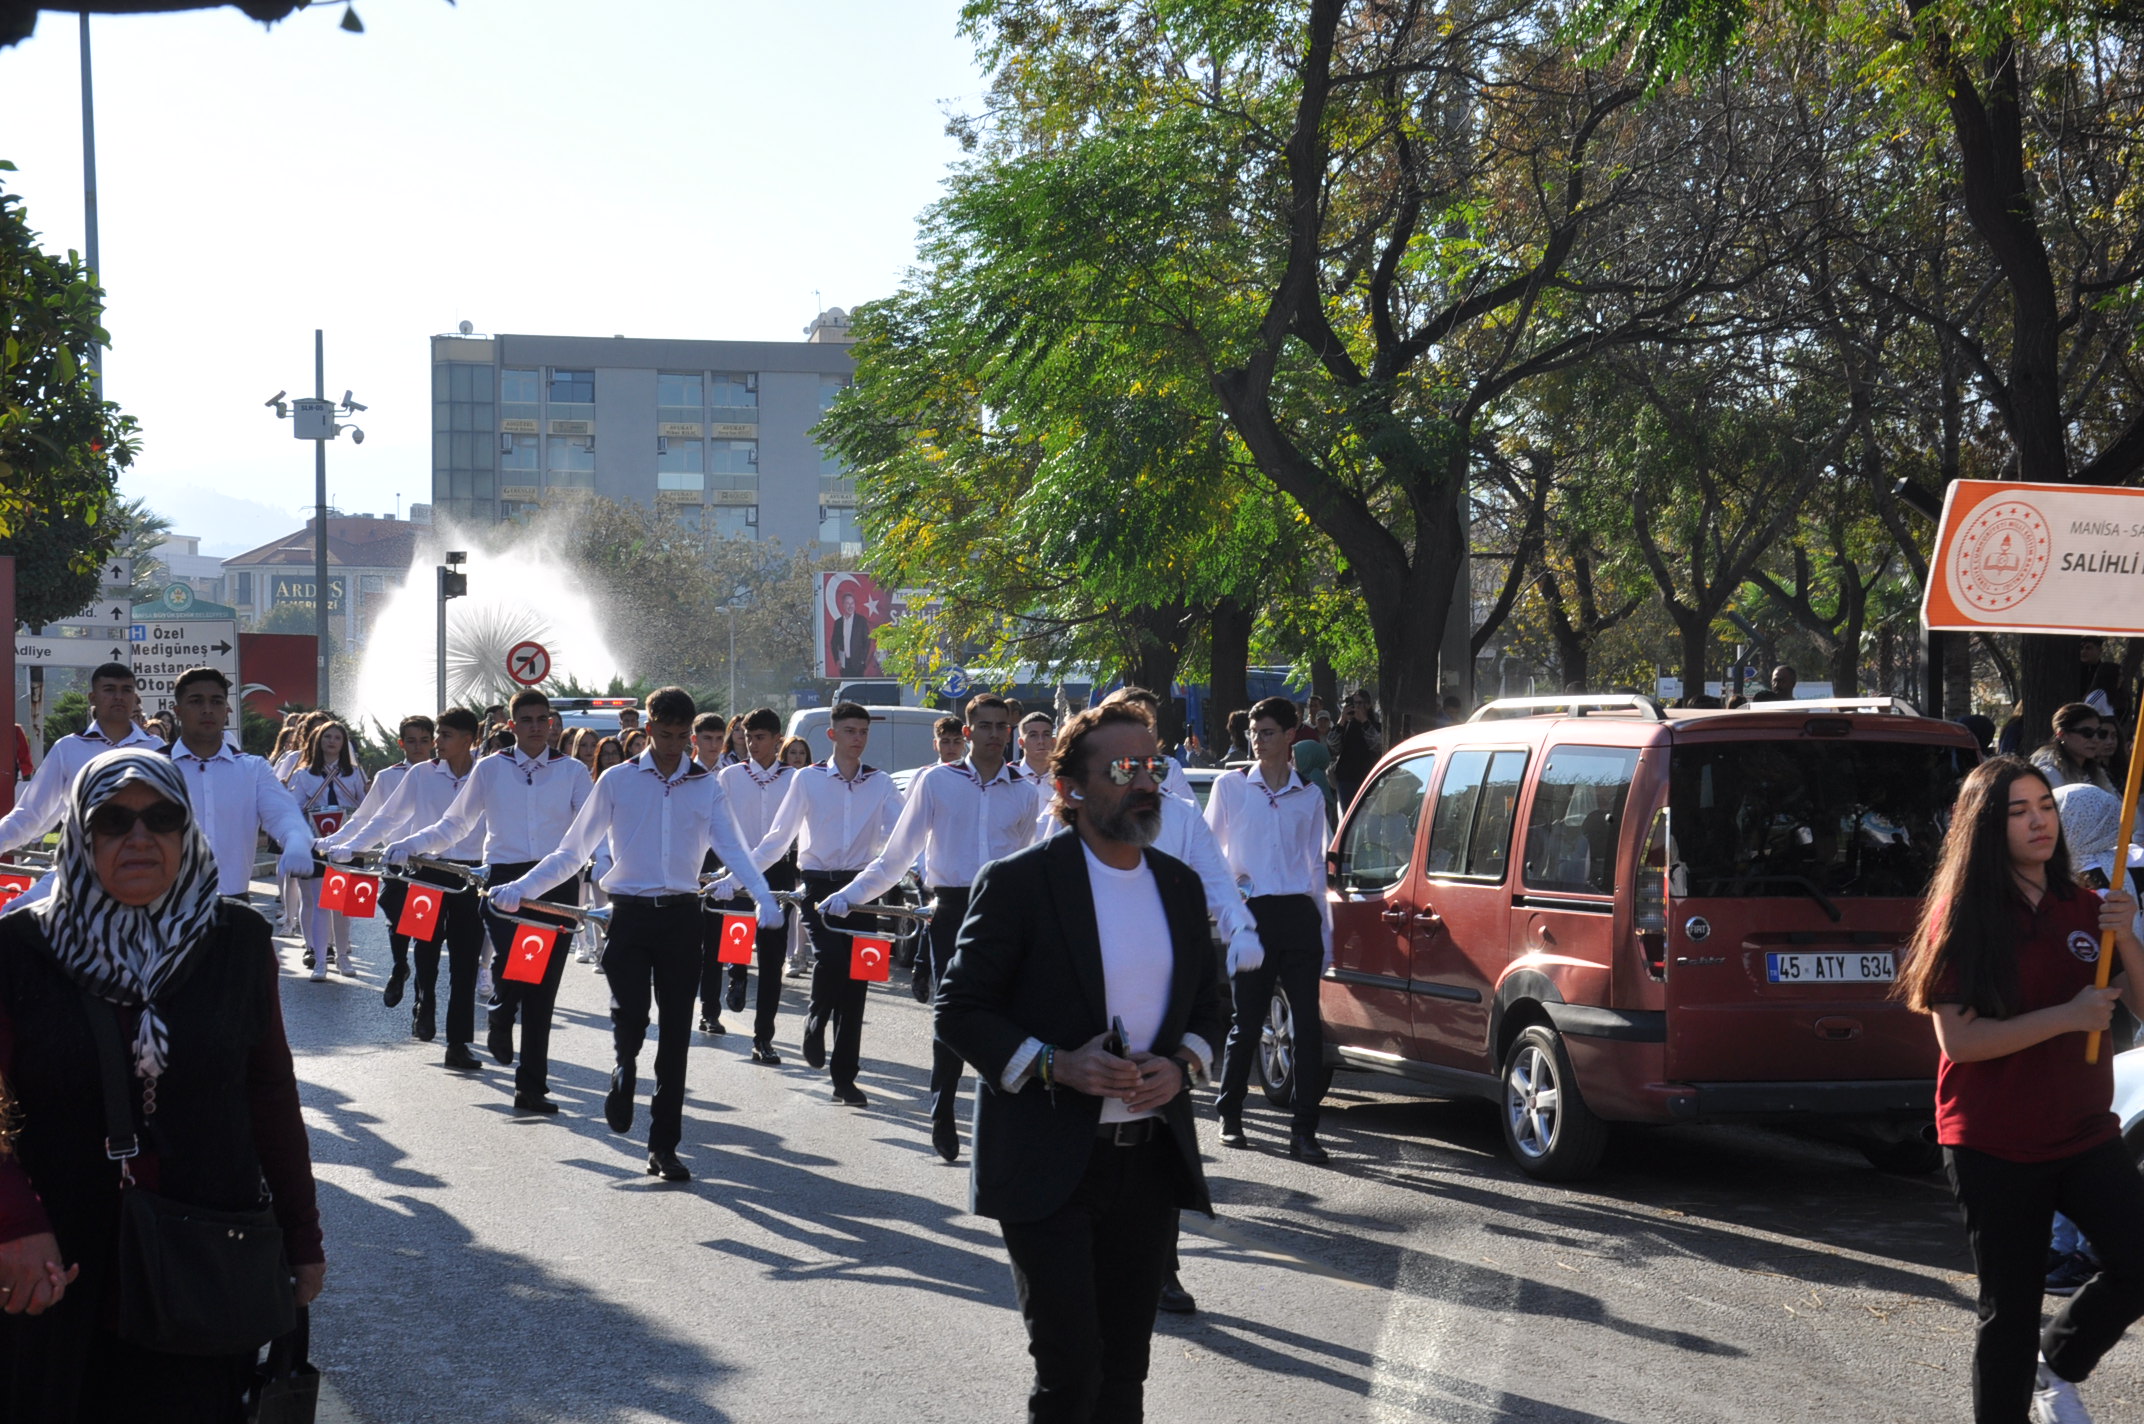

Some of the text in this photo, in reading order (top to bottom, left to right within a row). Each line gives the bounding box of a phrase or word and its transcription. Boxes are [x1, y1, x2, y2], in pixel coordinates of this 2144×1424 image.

[2070, 520, 2120, 536] MANİSA
[2061, 550, 2140, 574] SALİHLİ
[275, 580, 343, 598] ARDS
[153, 625, 184, 640] Özel
[131, 643, 208, 657] Medigüneş
[1689, 924, 1706, 934] FIAT
[1780, 956, 1800, 978] 45
[1816, 956, 1845, 978] ATY
[1861, 956, 1892, 978] 634
